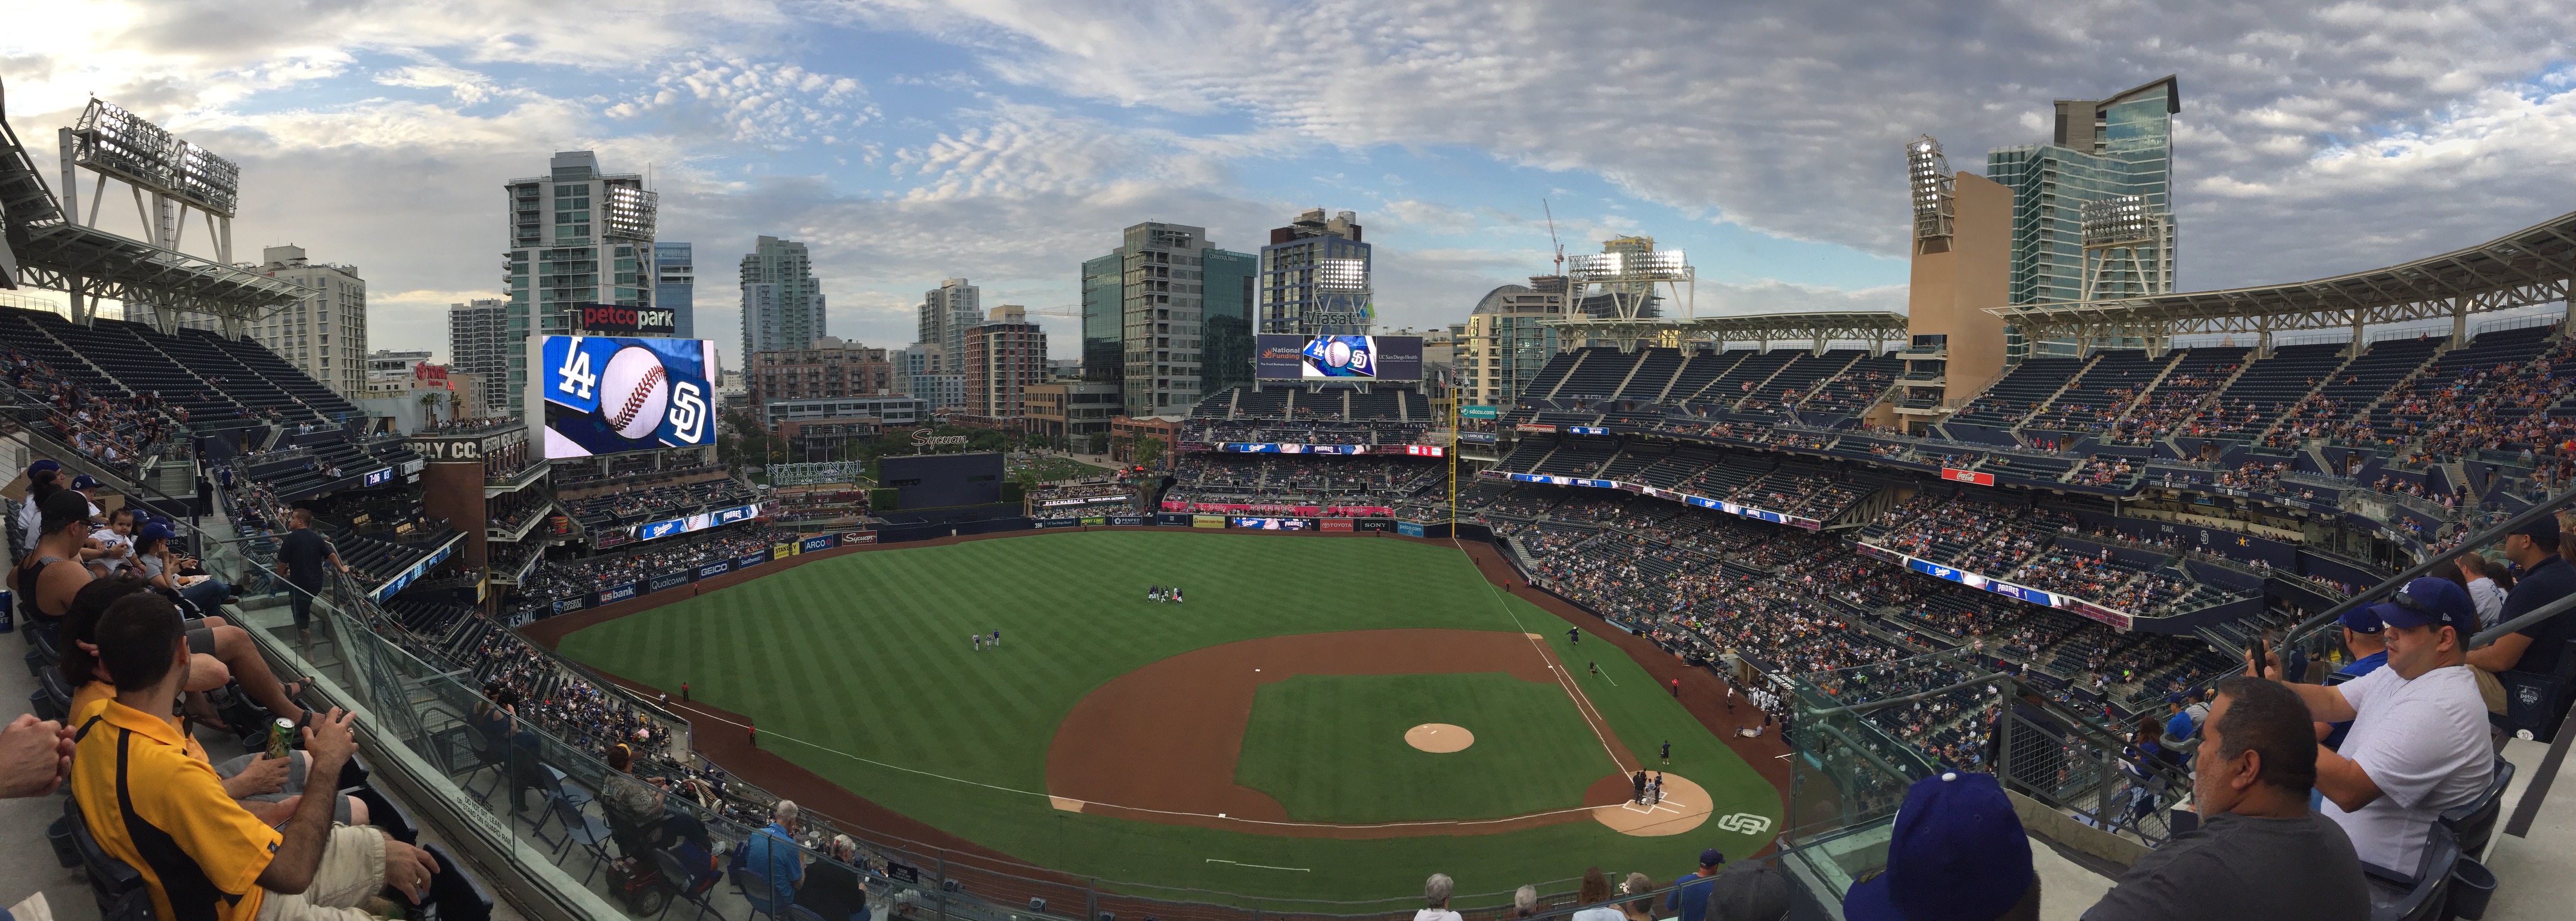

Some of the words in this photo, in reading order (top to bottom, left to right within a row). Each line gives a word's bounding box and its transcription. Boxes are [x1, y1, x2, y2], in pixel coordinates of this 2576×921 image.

[1306, 311, 1355, 325] Viasat
[1313, 340, 1324, 357] LA
[426, 365, 447, 380] TOYOTA
[559, 337, 596, 400] LA
[669, 381, 706, 444] SD
[482, 436, 500, 453] WESTERN
[501, 433, 512, 447] METAL
[512, 429, 524, 443] SUPPLY
[911, 429, 968, 449] Sycuan
[451, 442, 481, 459] CO.
[1249, 444, 1266, 452] Dodgers
[766, 460, 865, 476] NATIONAL
[370, 473, 380, 484] 7:06
[774, 473, 858, 486] UNIVERSITY
[1643, 486, 1656, 497] PADRES
[2284, 498, 2290, 506] 31
[2290, 501, 2309, 510] WINFIELD
[723, 509, 741, 522] PADRES
[1747, 508, 1760, 517] PADRES
[654, 522, 673, 536] Dodgers
[2162, 525, 2174, 534] RAK
[806, 539, 825, 550] ARCO
[846, 533, 874, 543] Sycuan
[741, 556, 760, 565] Southwest
[701, 563, 727, 576] GEICO
[1934, 567, 1950, 576] Dodgers
[1998, 583, 2019, 597] PADRES
[564, 598, 582, 606] ROCKET
[564, 603, 582, 611] LEAGUE
[509, 610, 536, 628] ASML
[2520, 693, 2537, 702] petco
[470, 790, 494, 815] PLEASE
[465, 796, 471, 806] DO
[489, 815, 501, 830] LEAN
[457, 797, 463, 806] OR
[463, 804, 476, 818] STAND
[476, 815, 484, 824] ON
[484, 820, 501, 838] GUARD
[501, 833, 512, 847] RAIL
